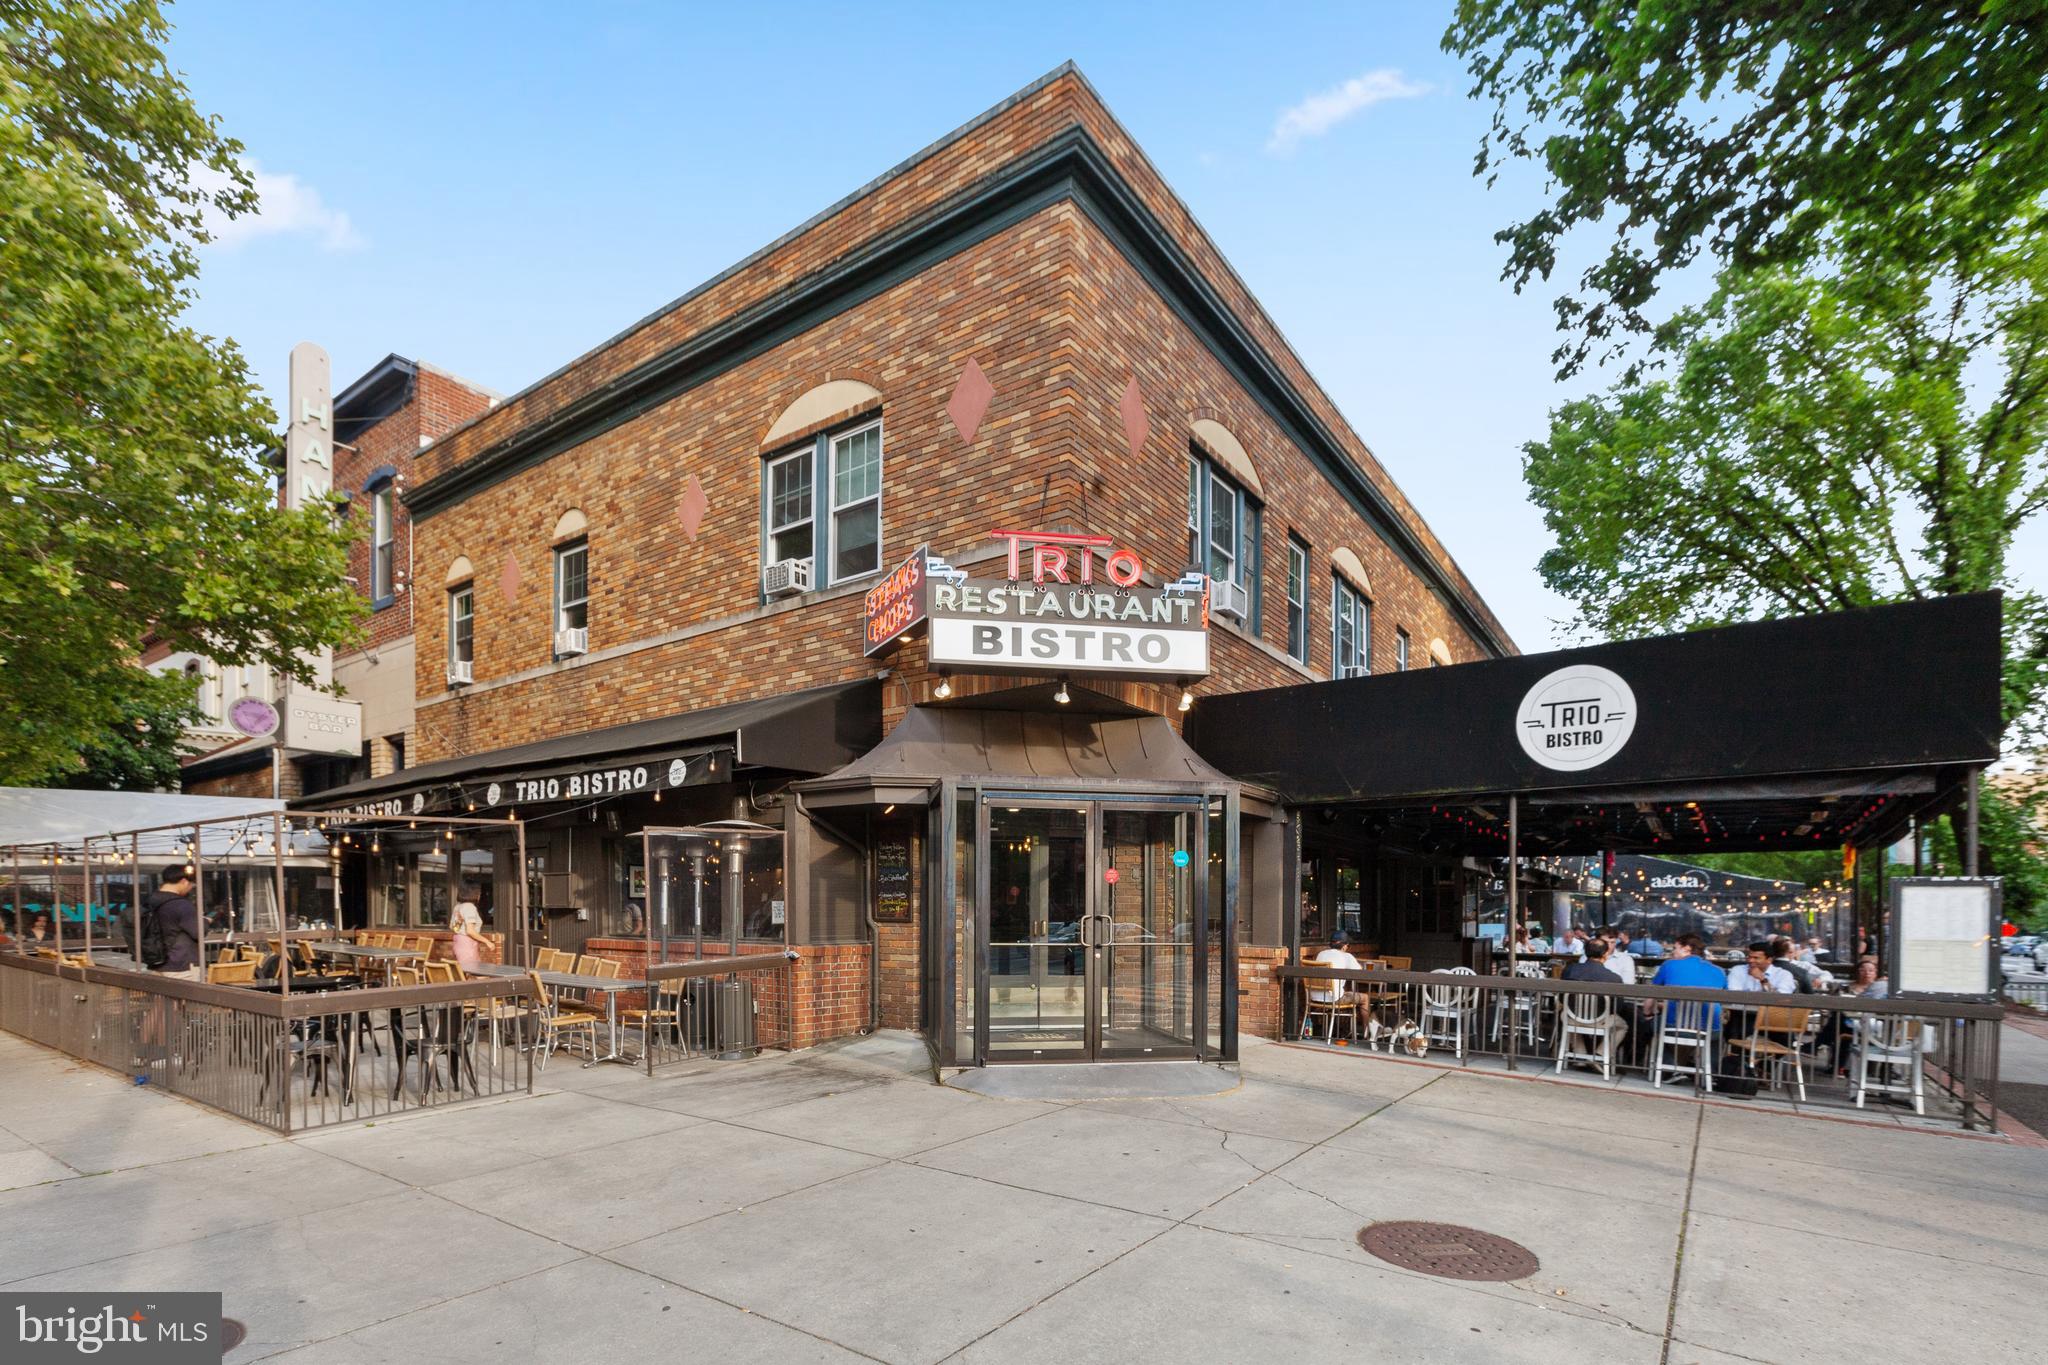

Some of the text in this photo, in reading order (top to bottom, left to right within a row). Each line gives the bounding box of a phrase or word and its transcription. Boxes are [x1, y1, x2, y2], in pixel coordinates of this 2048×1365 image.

[989, 529, 1143, 586] TRIO
[935, 584, 1195, 625] RESTAURANT
[972, 625, 1171, 663] BISTRO
[294, 709, 356, 725] OYSTER
[309, 721, 343, 734] BAR
[1541, 698, 1601, 728] TRIO
[1546, 730, 1603, 748] BISTRO
[516, 779, 559, 801] TRIO
[570, 767, 647, 797] BISTRO
